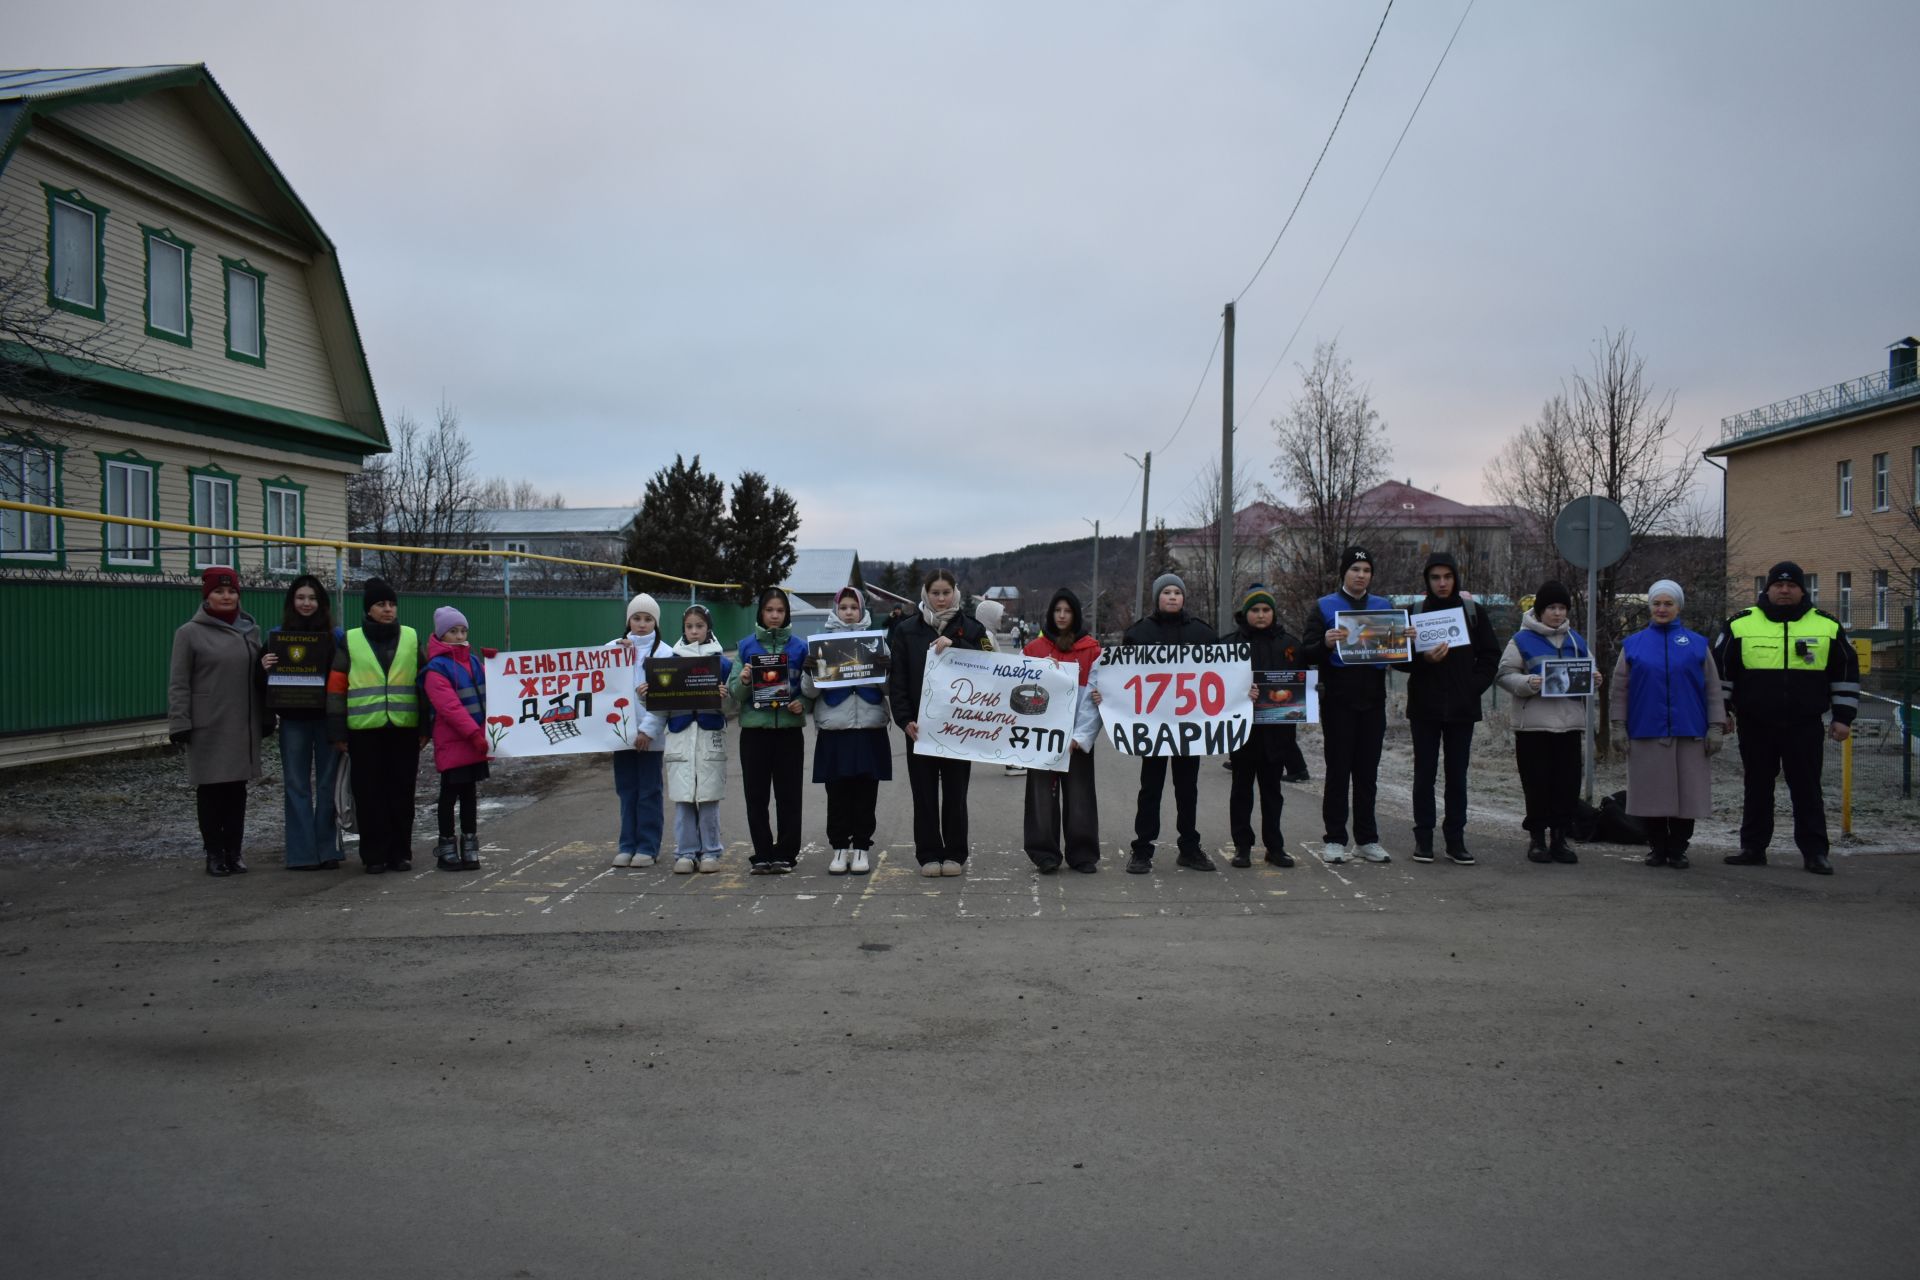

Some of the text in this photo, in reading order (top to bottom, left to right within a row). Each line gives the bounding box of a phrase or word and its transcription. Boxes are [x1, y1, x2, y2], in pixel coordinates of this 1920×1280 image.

[1100, 643, 1251, 665] ЗАФИКСИРОВАНО
[518, 670, 606, 698] ЖЕРТВ
[993, 660, 1043, 684] ноября
[950, 678, 1001, 707] День
[1124, 671, 1226, 717] 1750
[952, 707, 1018, 725] памяти
[937, 722, 1065, 753] жертв ДТП
[1113, 714, 1247, 756] АВАРИЙ
